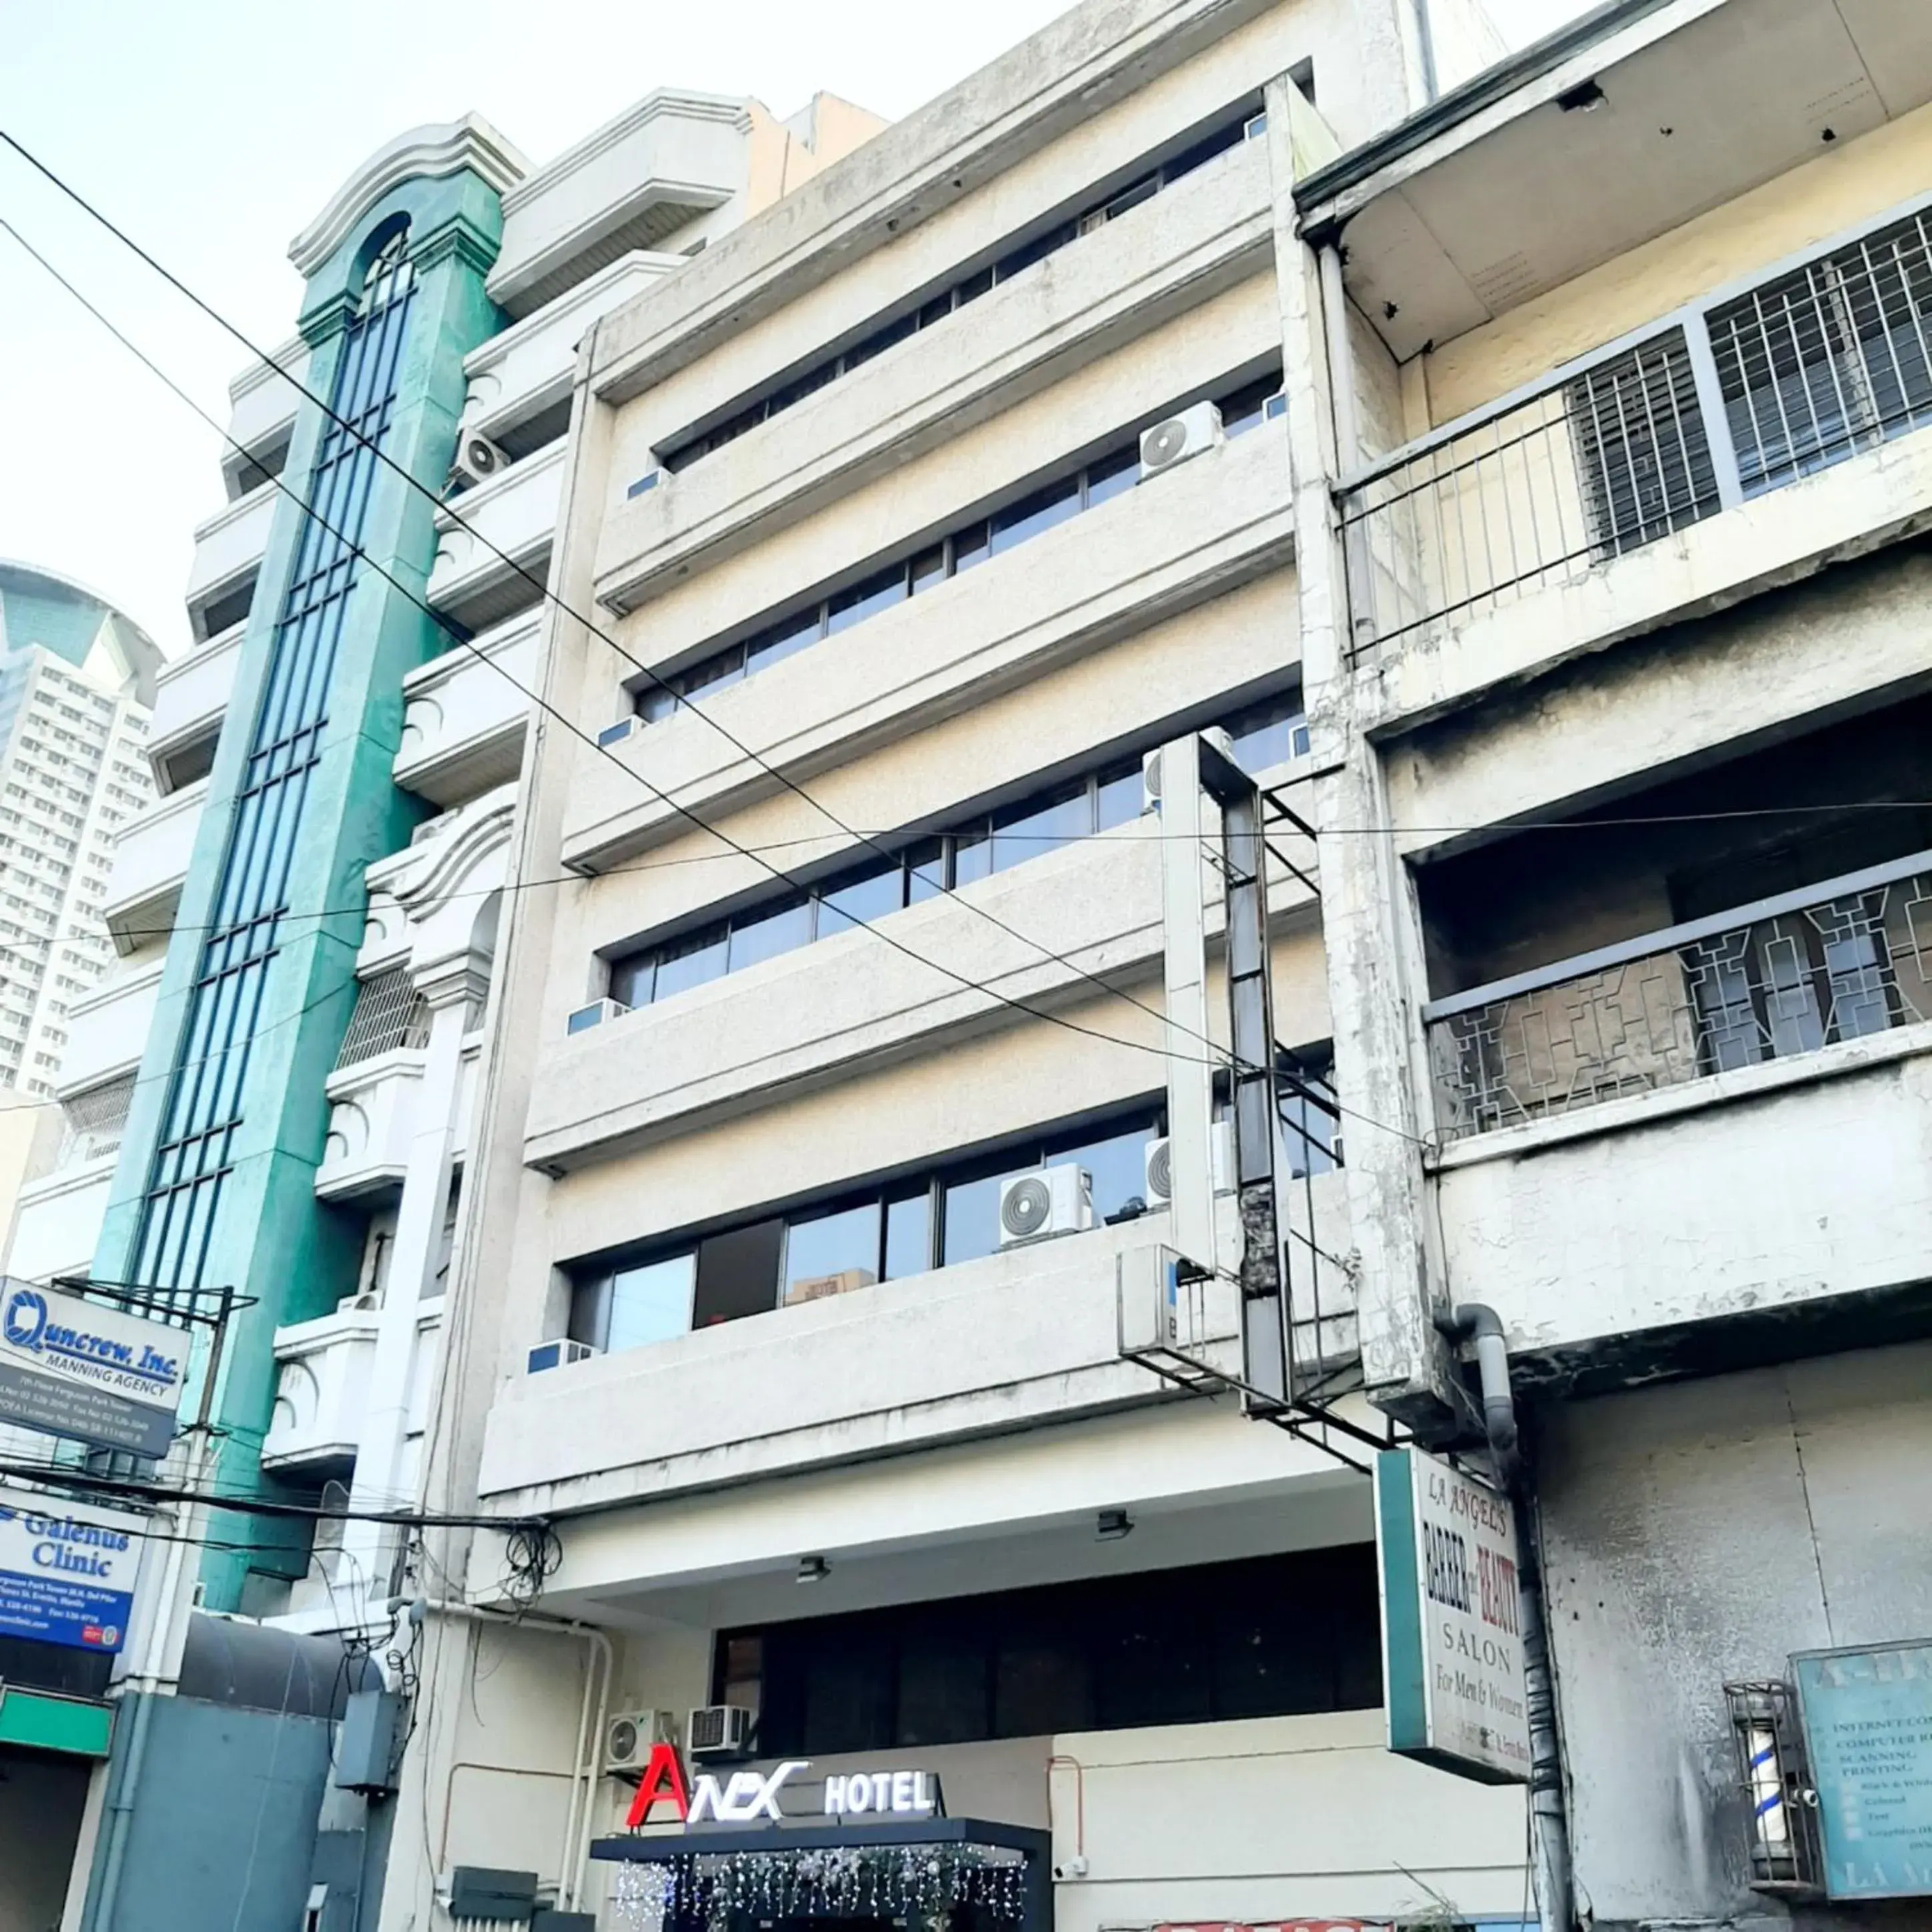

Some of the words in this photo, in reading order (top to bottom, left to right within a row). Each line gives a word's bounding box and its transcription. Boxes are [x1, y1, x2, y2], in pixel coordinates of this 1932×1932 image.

[45, 1353, 113, 1383] MANNING
[113, 1373, 168, 1398] AGENCY
[137, 1345, 179, 1377] Inc.
[25, 1512, 129, 1552] Galenus
[32, 1541, 113, 1577] Clinic
[1423, 1519, 1472, 1615] BARBER
[1443, 1622, 1511, 1675] SALON
[1435, 1663, 1454, 1691] For
[1455, 1669, 1477, 1702] Men
[1488, 1681, 1524, 1720] Women
[1833, 1719, 1902, 1733] INTERNET
[1835, 1734, 1916, 1749] COMPUTER
[1839, 1750, 1917, 1763] SCANNING
[1842, 1763, 1914, 1777] PRINTING
[825, 1771, 935, 1815] HOTEL
